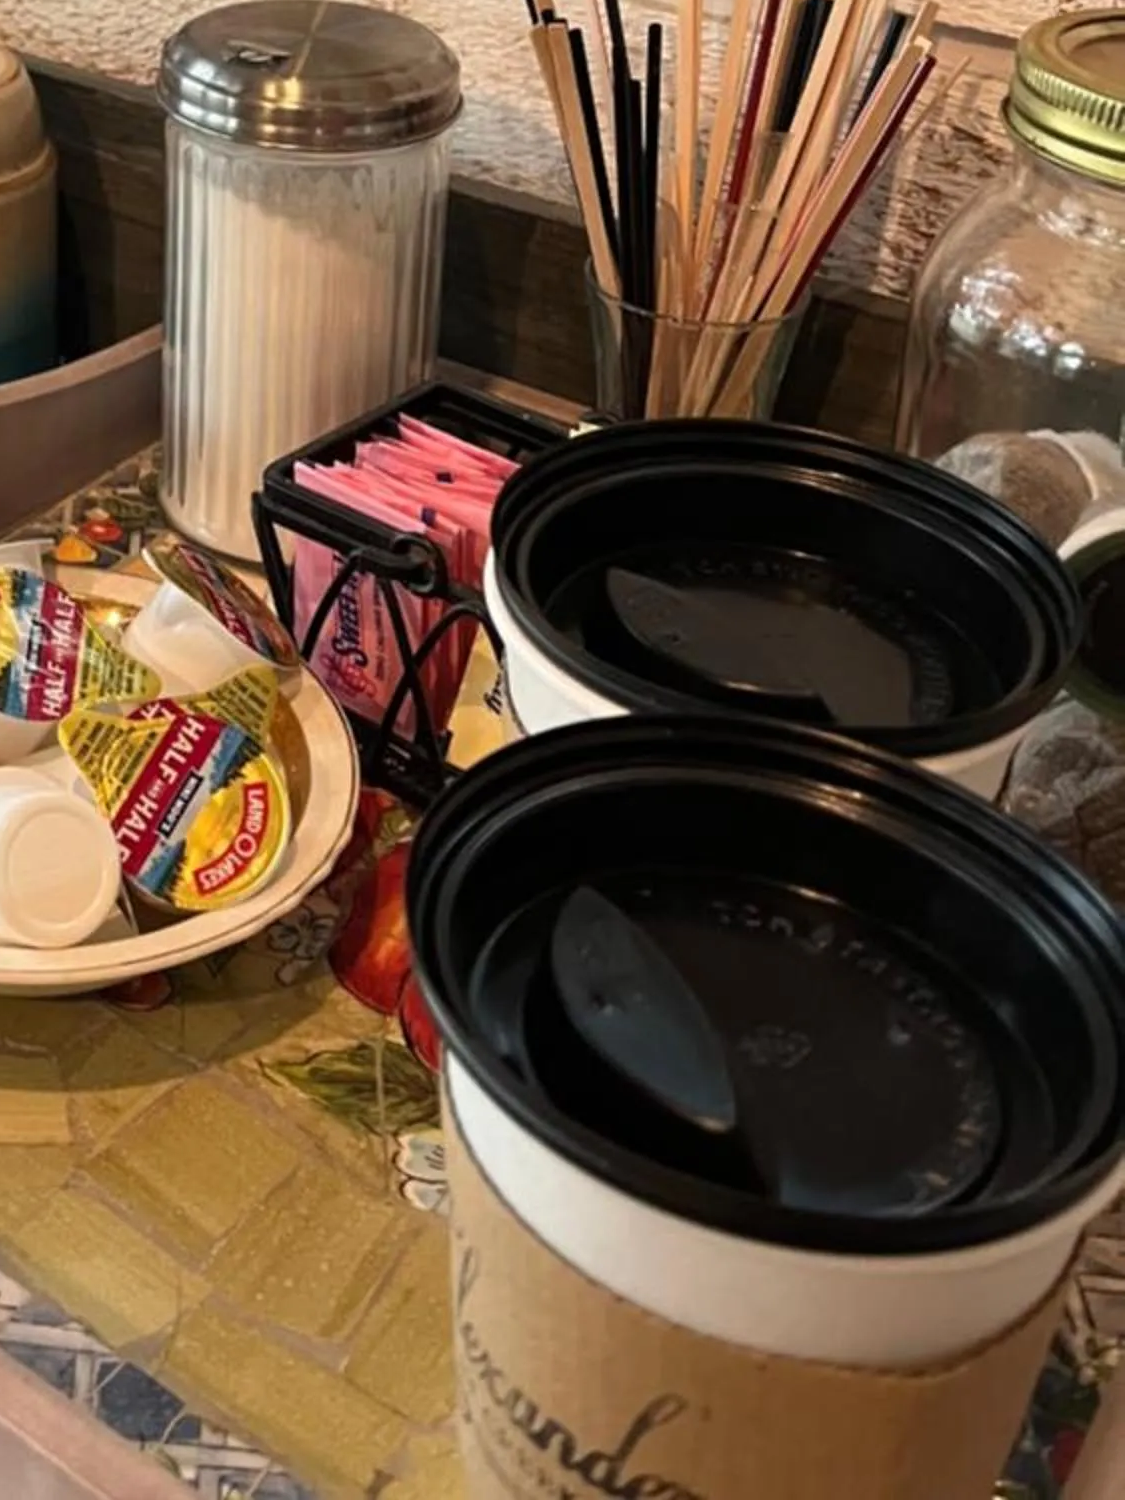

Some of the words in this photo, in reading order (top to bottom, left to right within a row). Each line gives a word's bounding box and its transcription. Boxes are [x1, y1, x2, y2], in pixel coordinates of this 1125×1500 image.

[53, 592, 76, 652] HALF
[41, 660, 68, 717] HALF
[159, 717, 206, 785] HALF
[246, 787, 266, 834] LAND
[234, 832, 257, 858] O
[197, 855, 244, 891] LAKES
